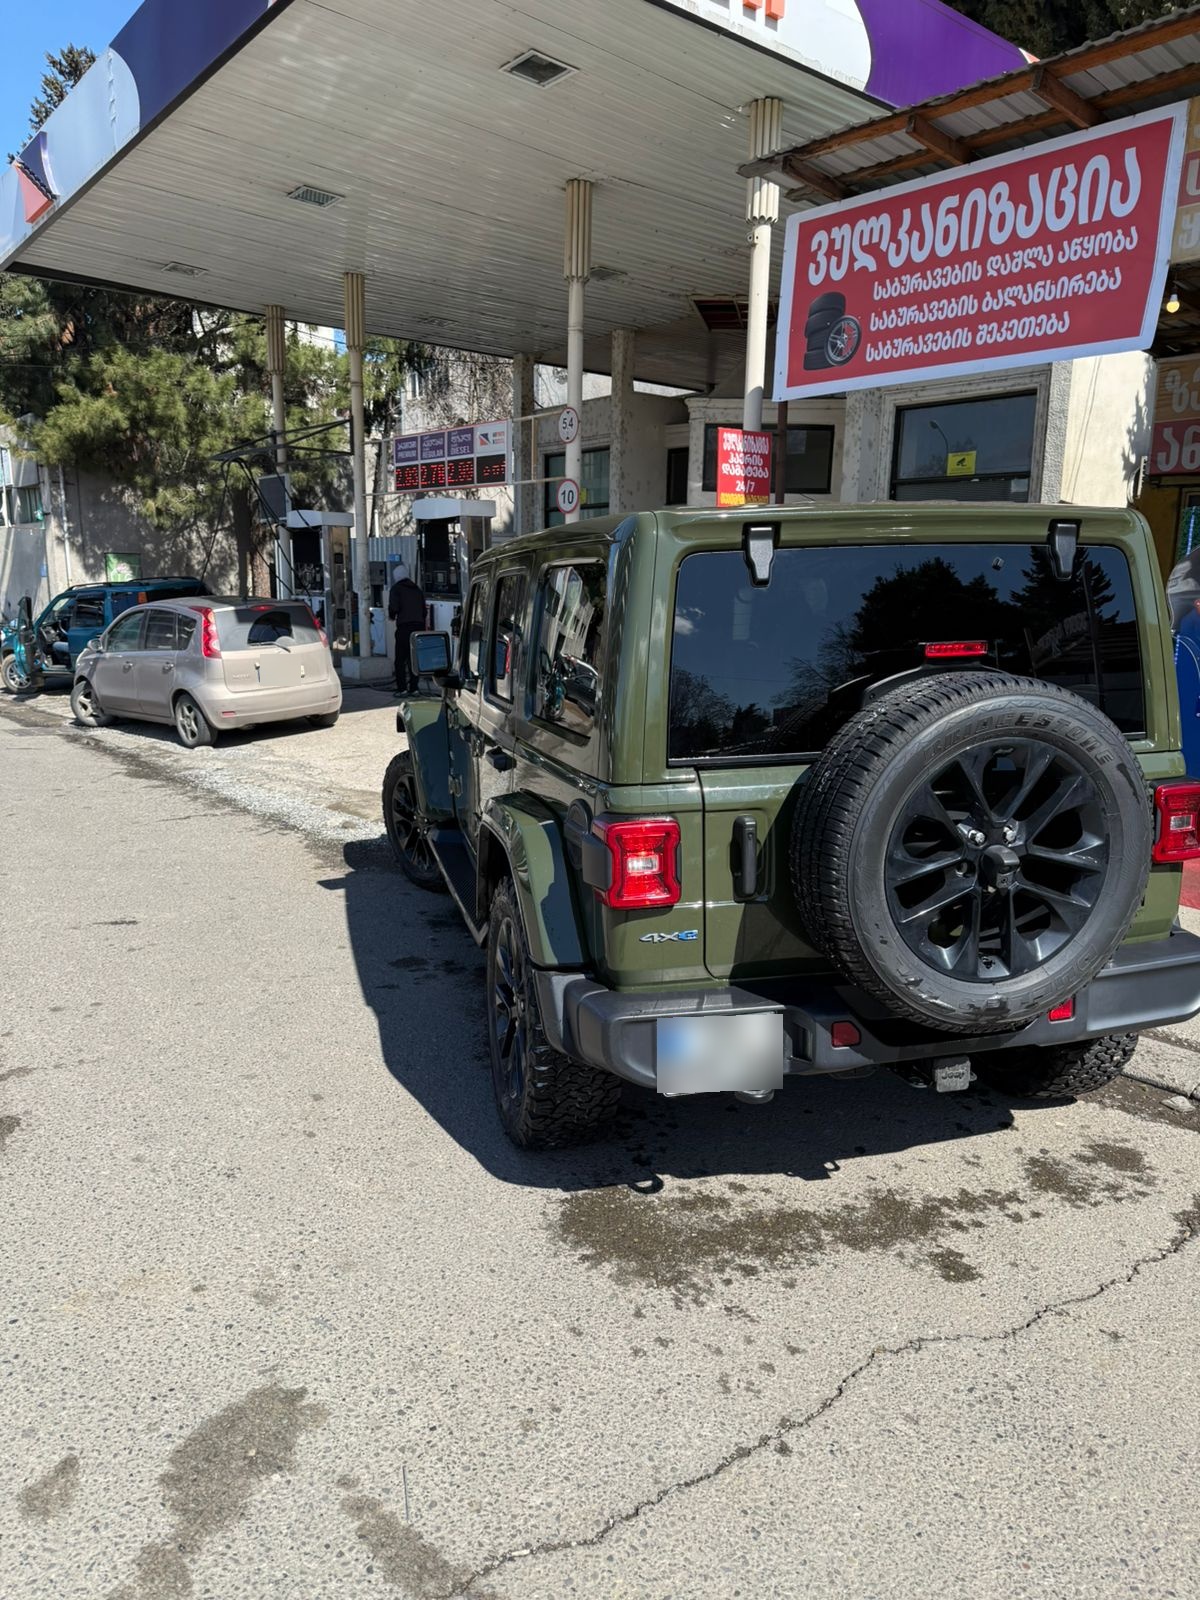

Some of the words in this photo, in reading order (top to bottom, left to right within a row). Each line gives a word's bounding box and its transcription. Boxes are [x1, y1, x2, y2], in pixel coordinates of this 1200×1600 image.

[808, 147, 1142, 286] ვულკანიზაცია
[873, 260, 982, 301] საბურავების
[987, 244, 1054, 277] დაშლა
[1058, 226, 1139, 264] აწყობა
[870, 291, 978, 332] საბურავების
[982, 266, 1123, 312] ბალანსირება
[865, 327, 972, 363] საბურავების
[976, 311, 1071, 346] შეკეთება
[451, 445, 471, 456] DIESEL
[722, 463, 769, 479] დამატება
[735, 480, 756, 493] 24/7
[561, 489, 574, 505] 10
[941, 1070, 965, 1080] Jeep
